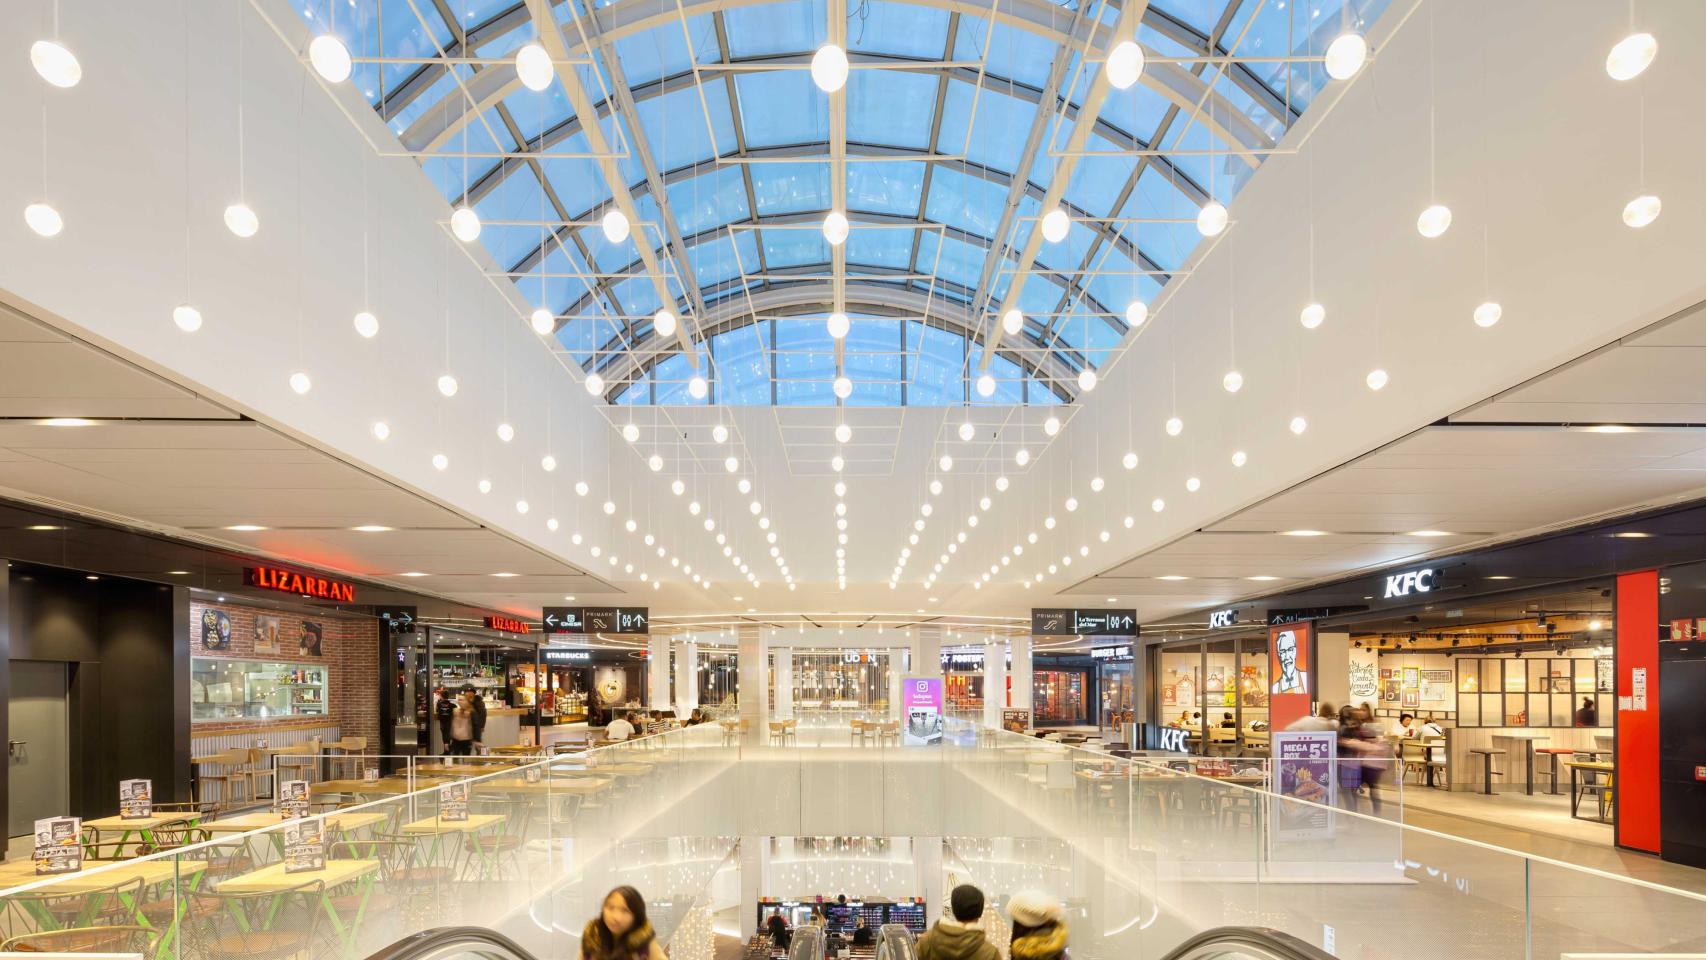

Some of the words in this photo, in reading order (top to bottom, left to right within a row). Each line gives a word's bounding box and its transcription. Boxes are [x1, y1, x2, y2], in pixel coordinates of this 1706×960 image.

[258, 567, 353, 602] LIZARRAN
[1384, 568, 1433, 598] KFC
[492, 615, 529, 634] LIZARRAN
[1209, 609, 1232, 629] KFC
[1160, 728, 1190, 753] KFC
[1283, 743, 1308, 752] MEGA
[1283, 752, 1300, 760] BOX
